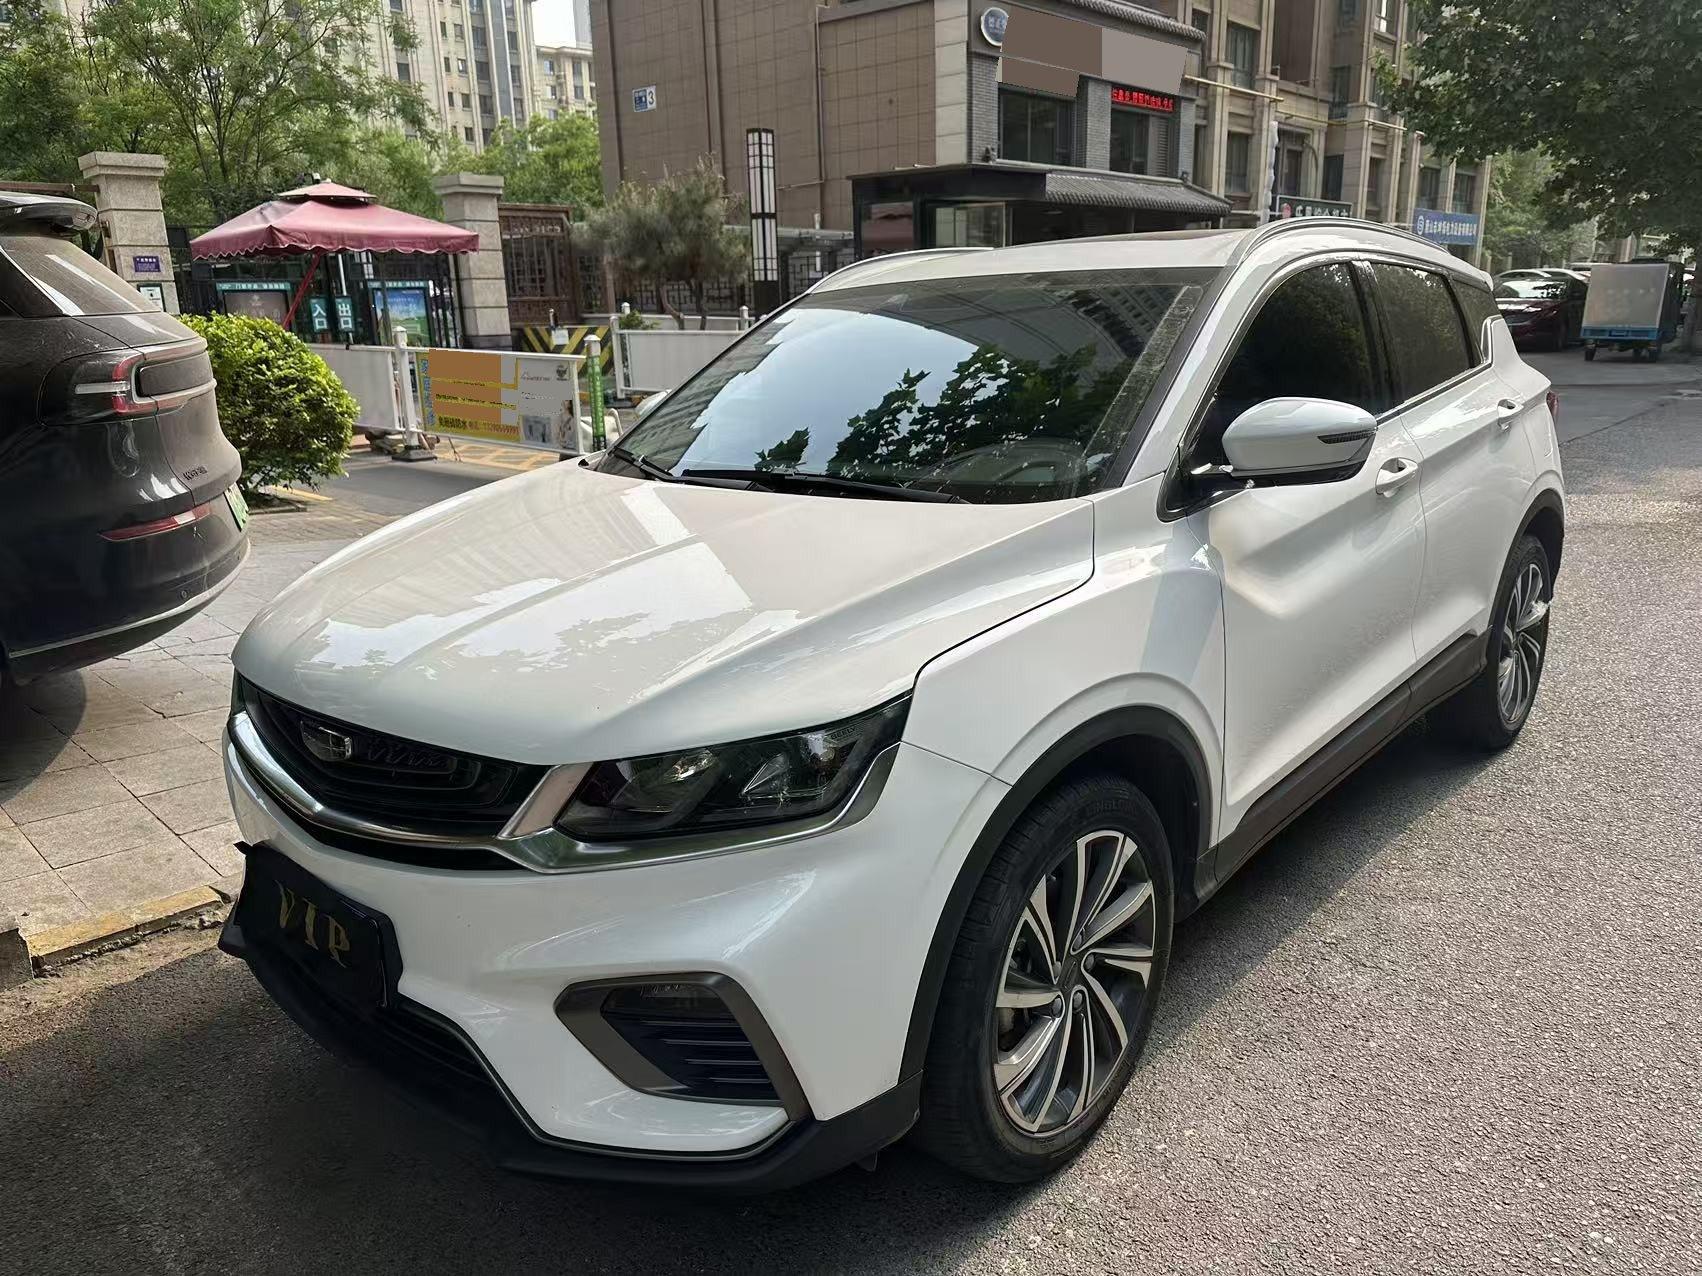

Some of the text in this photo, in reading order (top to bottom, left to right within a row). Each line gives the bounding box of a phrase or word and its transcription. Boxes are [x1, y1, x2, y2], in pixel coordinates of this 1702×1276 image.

[648, 90, 655, 105] 3
[313, 303, 328, 330] 入口
[338, 303, 353, 329] 出口
[275, 879, 351, 968] VIP
